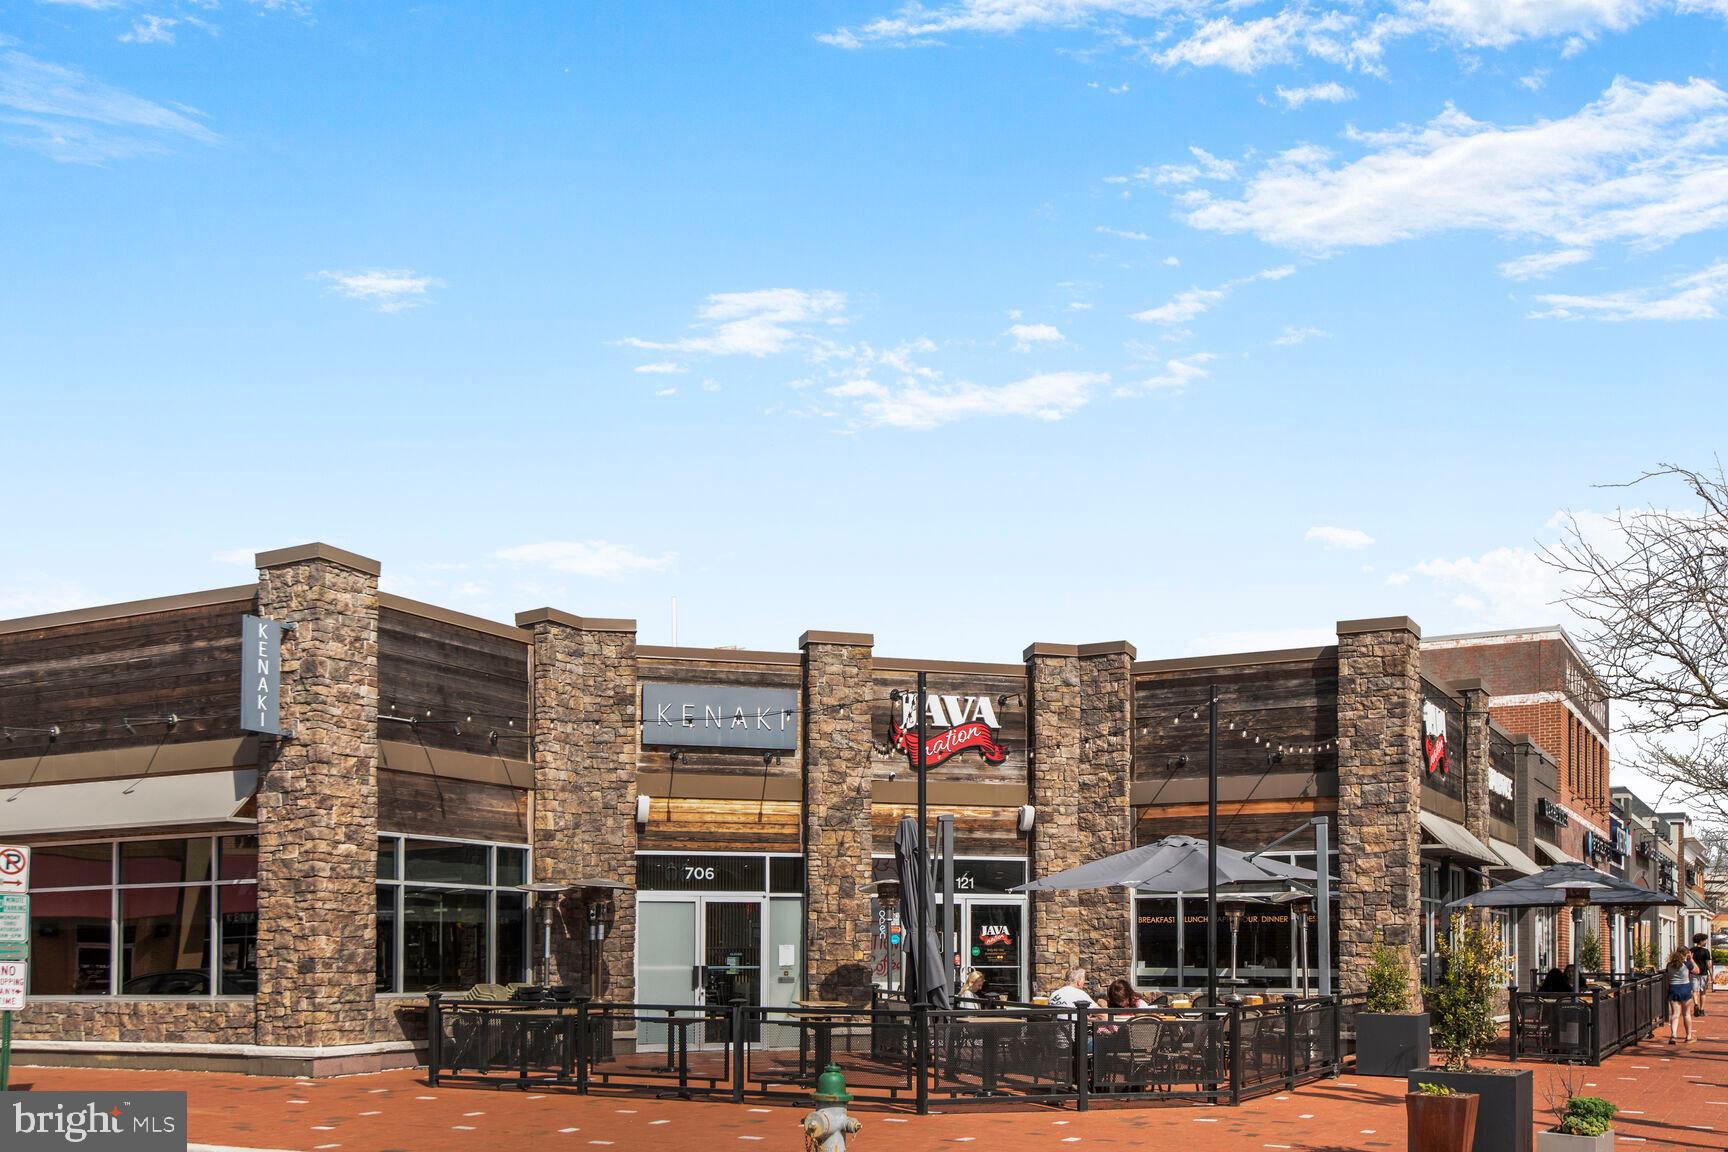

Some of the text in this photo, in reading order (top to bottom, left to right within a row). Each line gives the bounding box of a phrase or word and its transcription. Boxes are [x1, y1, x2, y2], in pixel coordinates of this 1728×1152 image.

[258, 622, 268, 727] KENAKI
[900, 692, 1002, 728] JAVA
[657, 703, 785, 731] KENAKI
[685, 867, 715, 880] 706
[955, 877, 974, 889] 121
[1184, 915, 1208, 923] LUNCH
[1261, 915, 1288, 923] DINNER
[981, 925, 1010, 937] JAVA
[1, 965, 16, 976] NO
